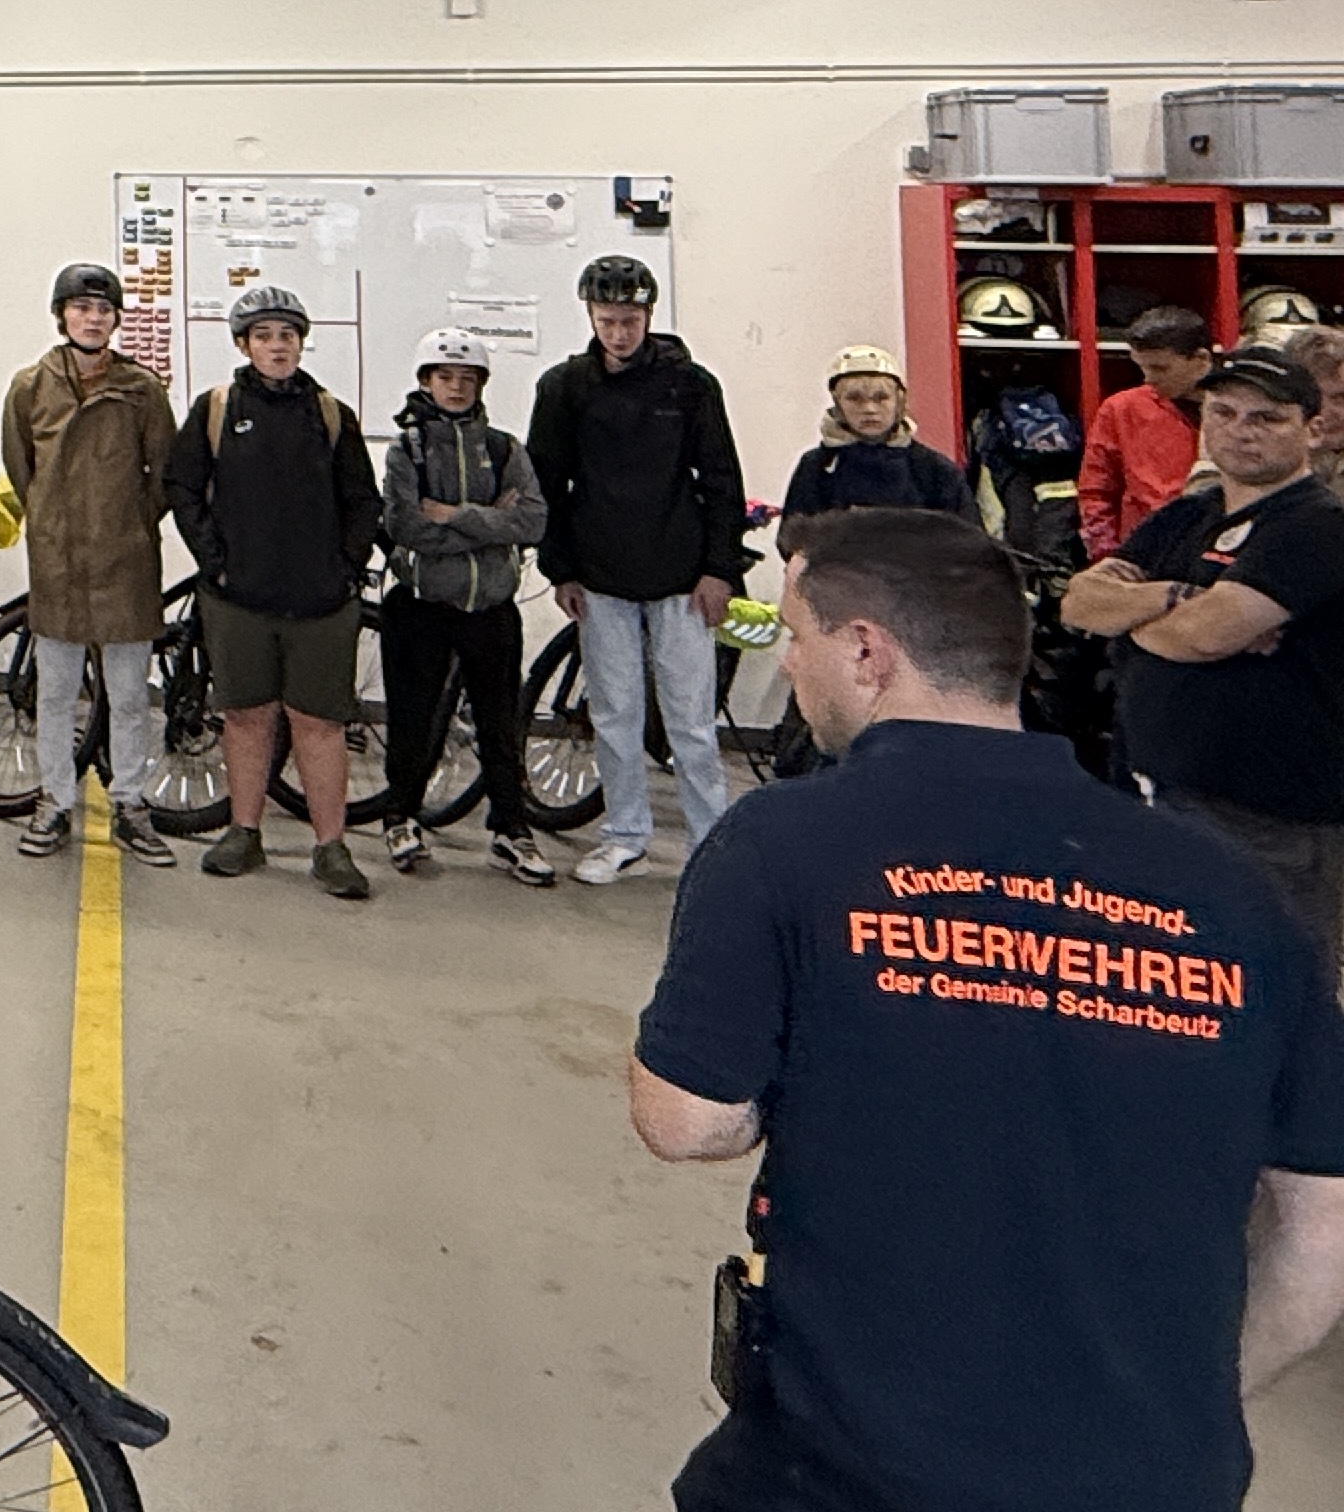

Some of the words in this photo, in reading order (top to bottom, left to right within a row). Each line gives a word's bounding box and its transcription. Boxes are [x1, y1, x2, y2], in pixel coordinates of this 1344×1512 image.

[883, 863, 995, 899] Kinder-
[1000, 873, 1055, 905] und
[1062, 882, 1196, 937] Jugend-
[847, 909, 1245, 1009] FEUERWEHREN
[876, 966, 925, 996] der
[930, 972, 1049, 1010] Gemeine
[1056, 989, 1222, 1040] Scharbeutz
